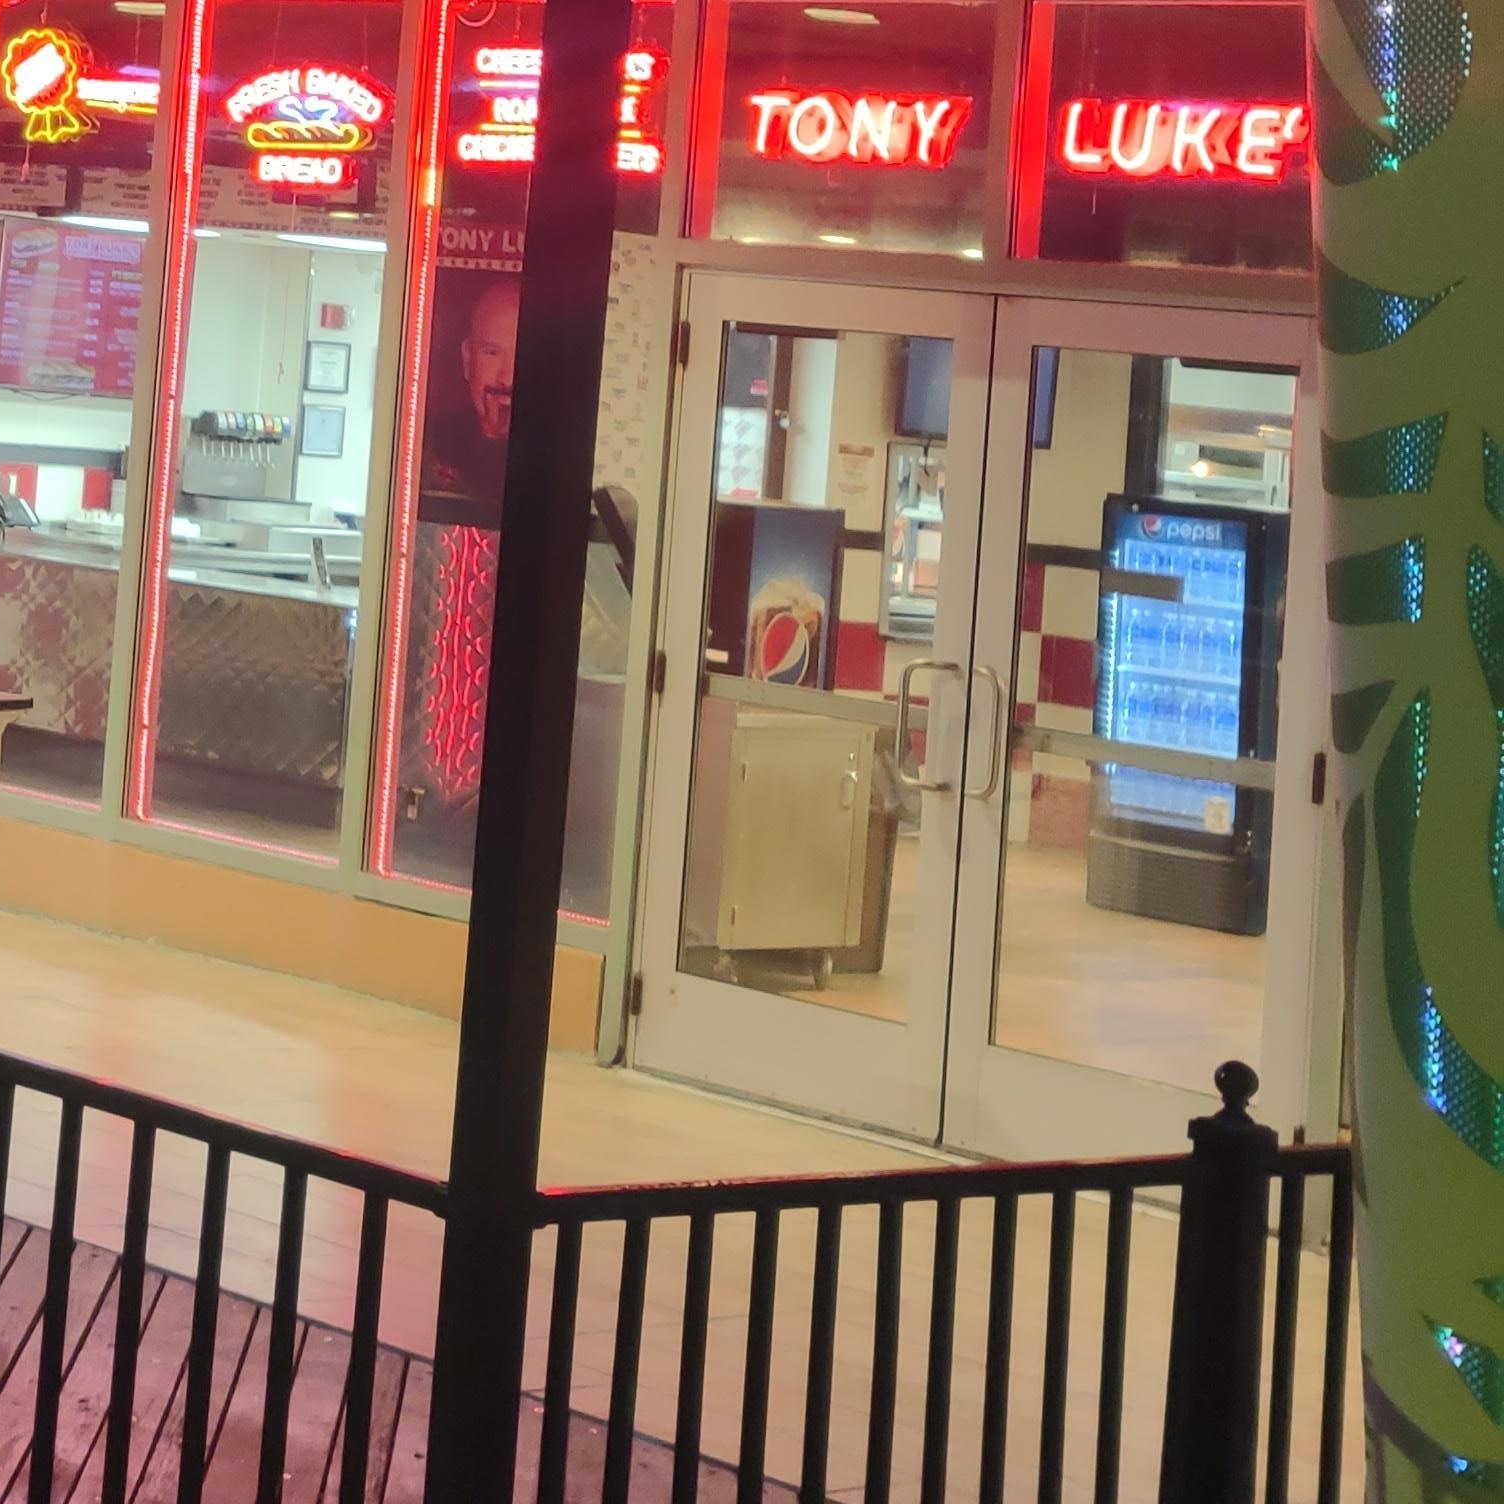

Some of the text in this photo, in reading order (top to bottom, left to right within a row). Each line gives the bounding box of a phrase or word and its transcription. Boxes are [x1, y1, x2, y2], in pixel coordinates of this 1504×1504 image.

[227, 68, 383, 122] FRESH BAKED
[749, 95, 1304, 175] TONY LUKE'
[259, 155, 342, 184] BREAD
[440, 227, 494, 251] ONY
[1166, 522, 1223, 542] pepsi
